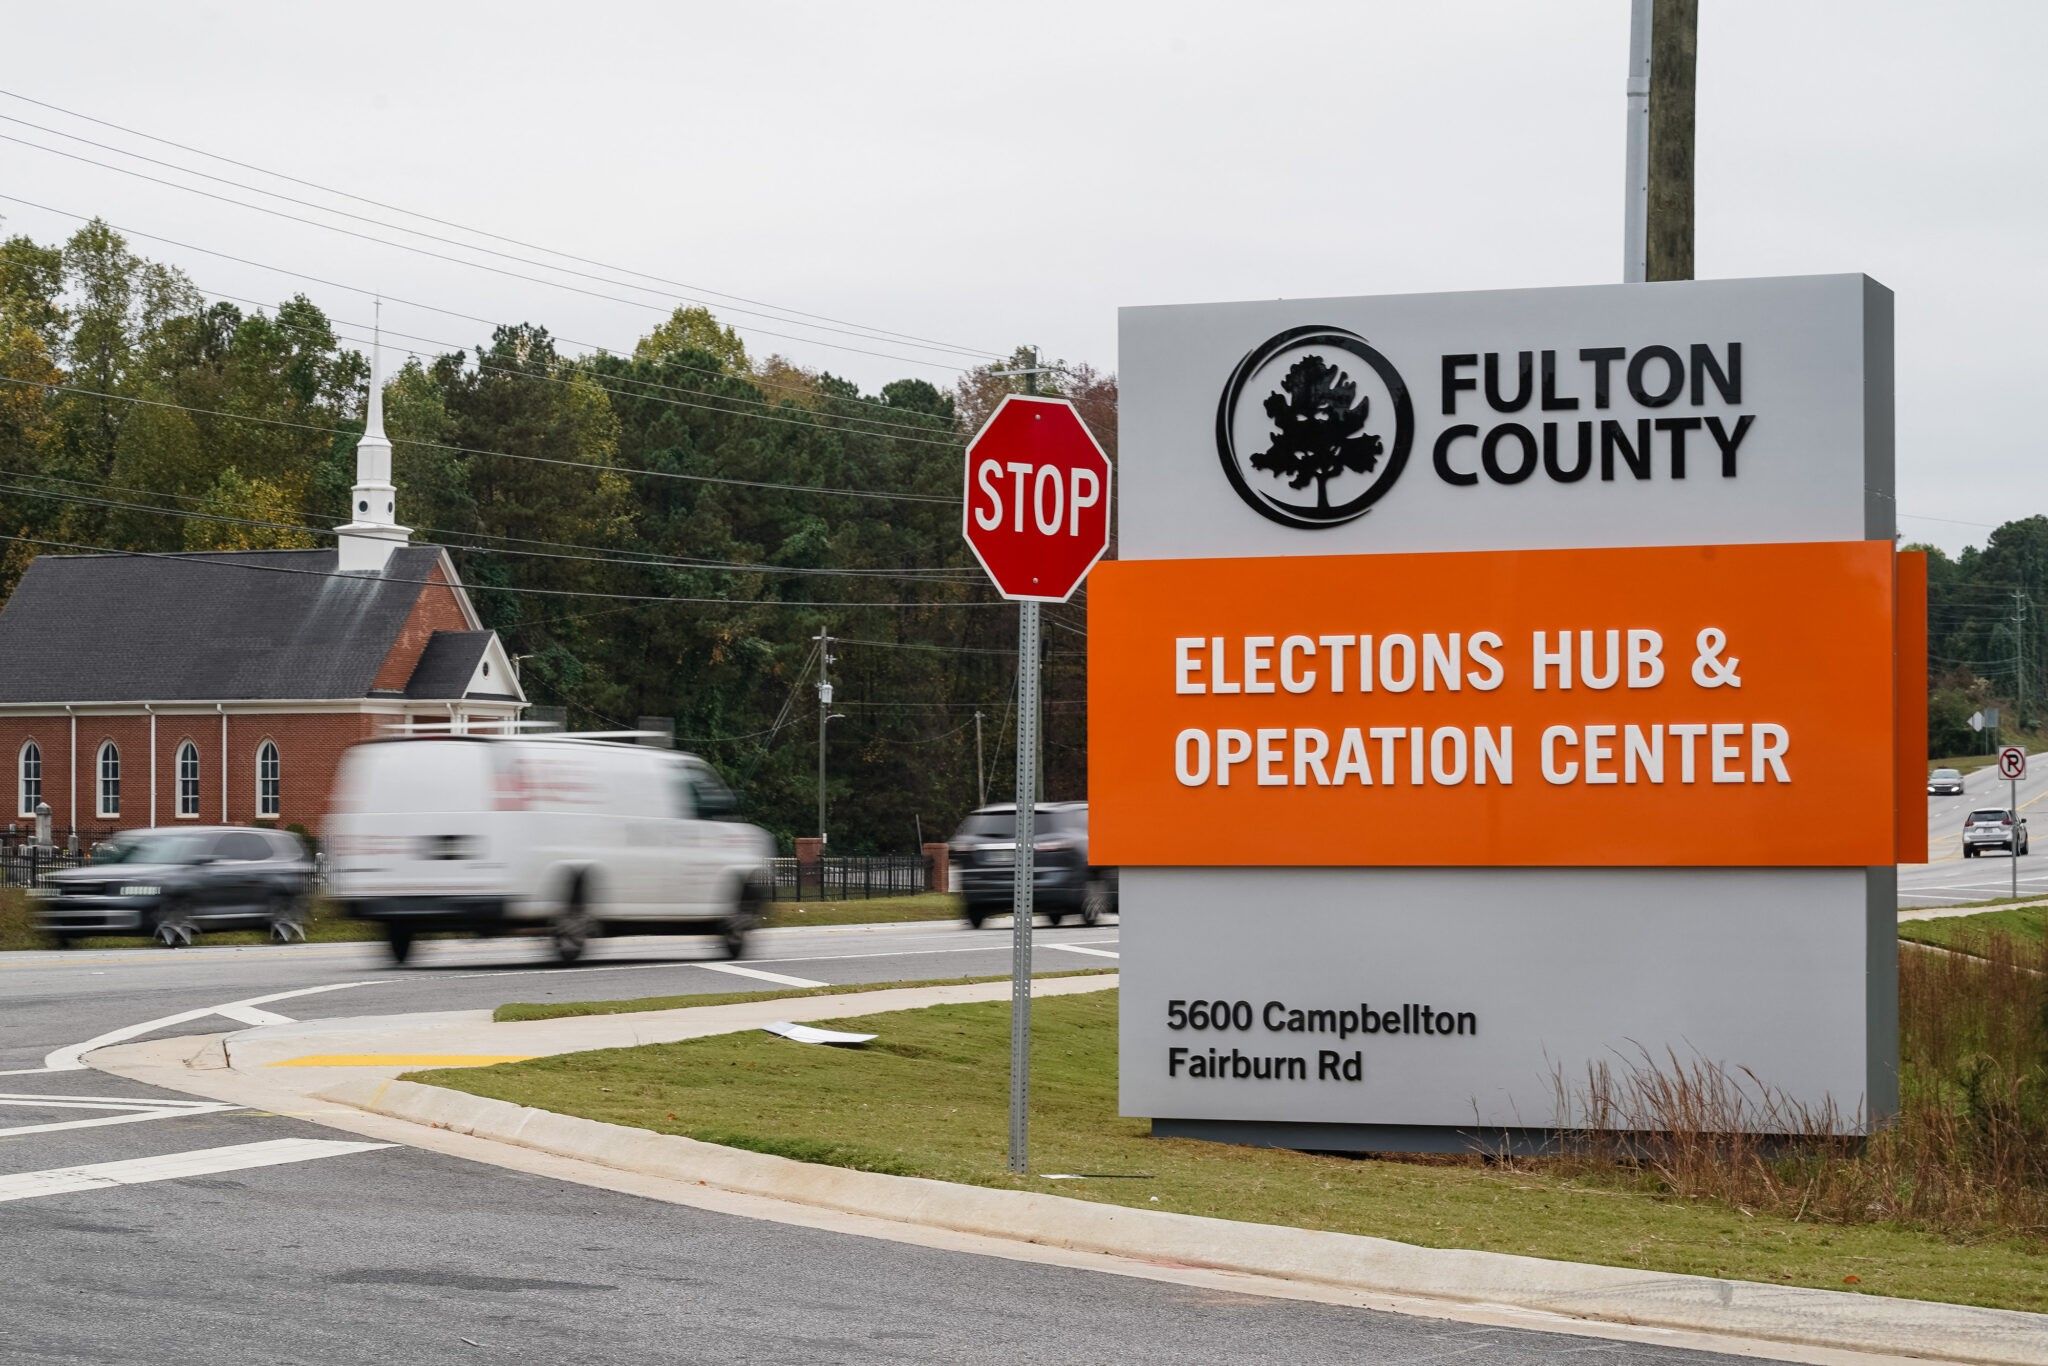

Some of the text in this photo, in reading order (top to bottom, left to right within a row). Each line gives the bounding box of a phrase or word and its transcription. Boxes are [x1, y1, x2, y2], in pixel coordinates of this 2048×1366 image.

[1441, 342, 1742, 416] FULTON
[1433, 415, 1756, 487] COUNTY
[974, 458, 1100, 537] STOP
[1175, 627, 1742, 694] ELECTIONS HUB &
[1175, 722, 1792, 787] OPERATION CENTER
[1166, 999, 1477, 1041] 5600 Campbellton
[1168, 1046, 1363, 1083] Fairburn Rd
